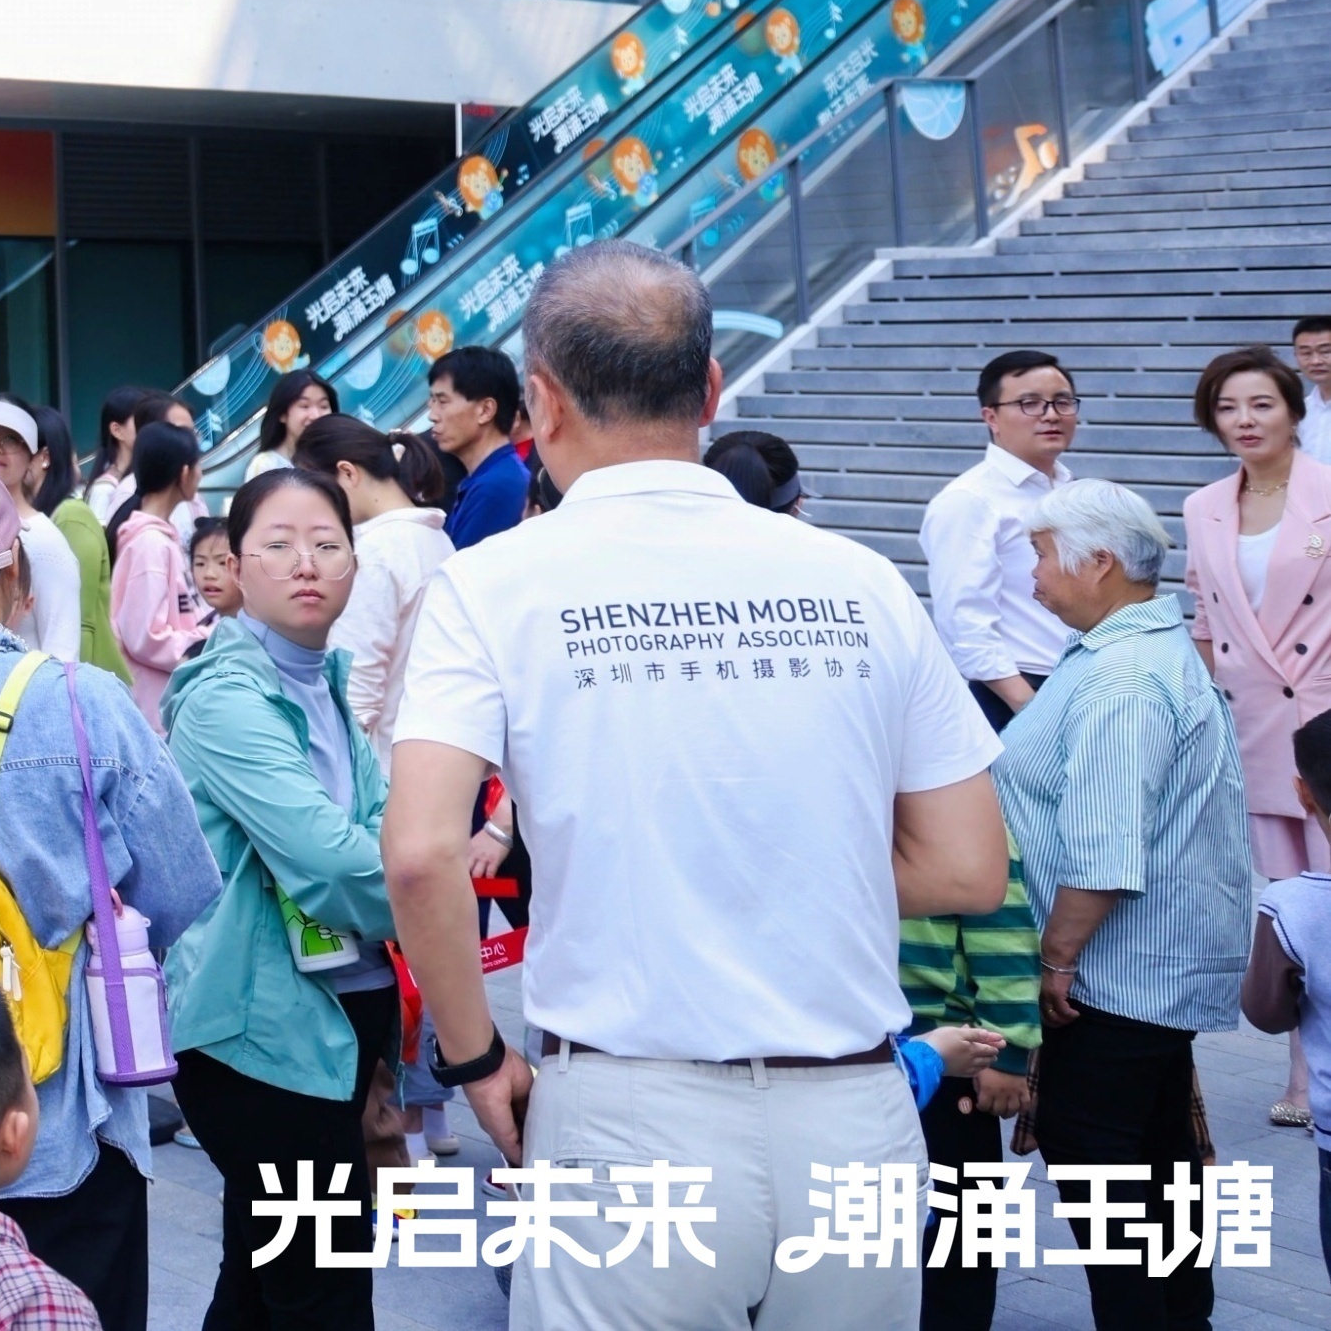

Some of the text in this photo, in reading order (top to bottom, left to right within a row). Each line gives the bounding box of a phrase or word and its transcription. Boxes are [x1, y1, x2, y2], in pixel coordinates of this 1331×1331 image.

[560, 598, 866, 634] SHENZHEN MOBILE
[566, 629, 870, 659] PHOTOGRAPHY ASSOCIATION
[574, 657, 872, 689] 深圳市手机摄影协会
